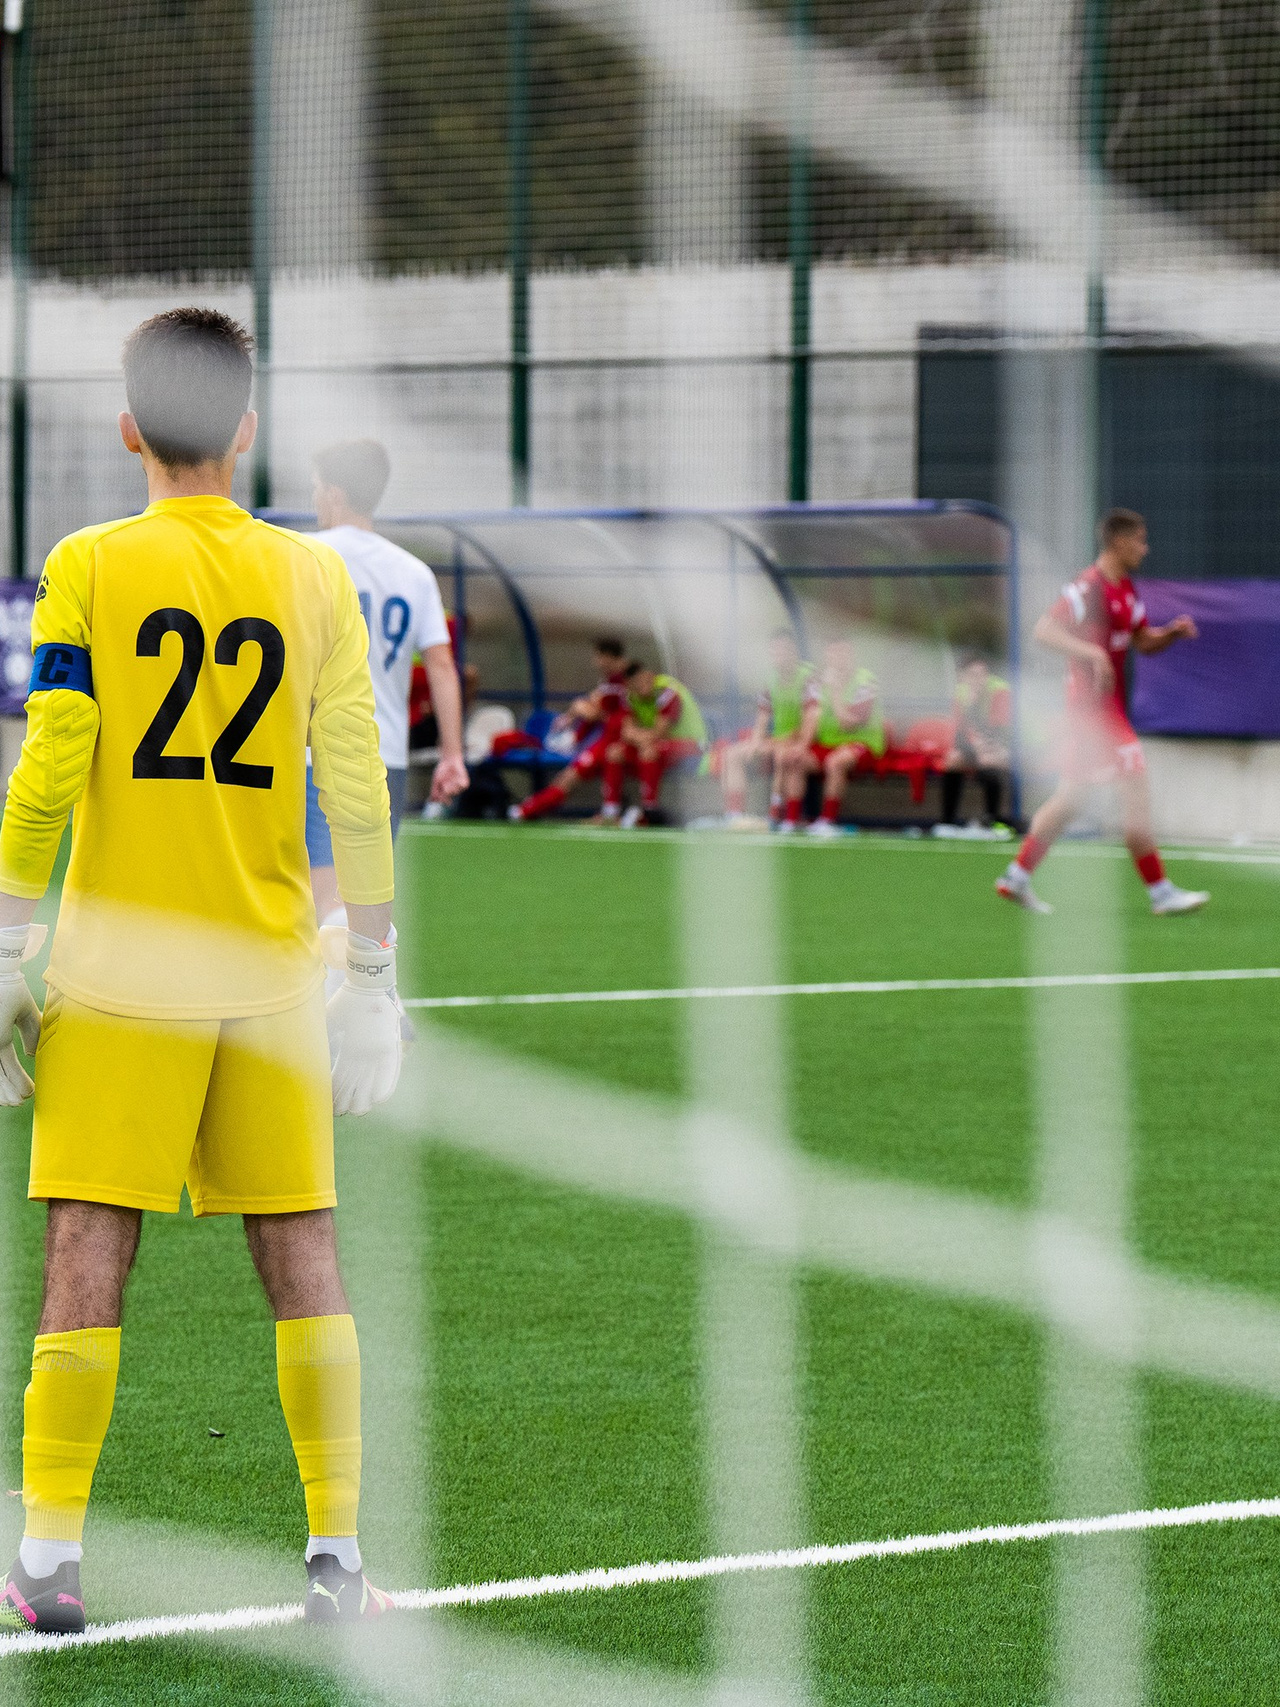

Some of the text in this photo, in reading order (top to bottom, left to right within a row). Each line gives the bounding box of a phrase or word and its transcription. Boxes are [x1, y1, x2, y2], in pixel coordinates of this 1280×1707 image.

[38, 648, 74, 684] C
[132, 607, 286, 790] 22
[346, 958, 391, 978] JÖGE
